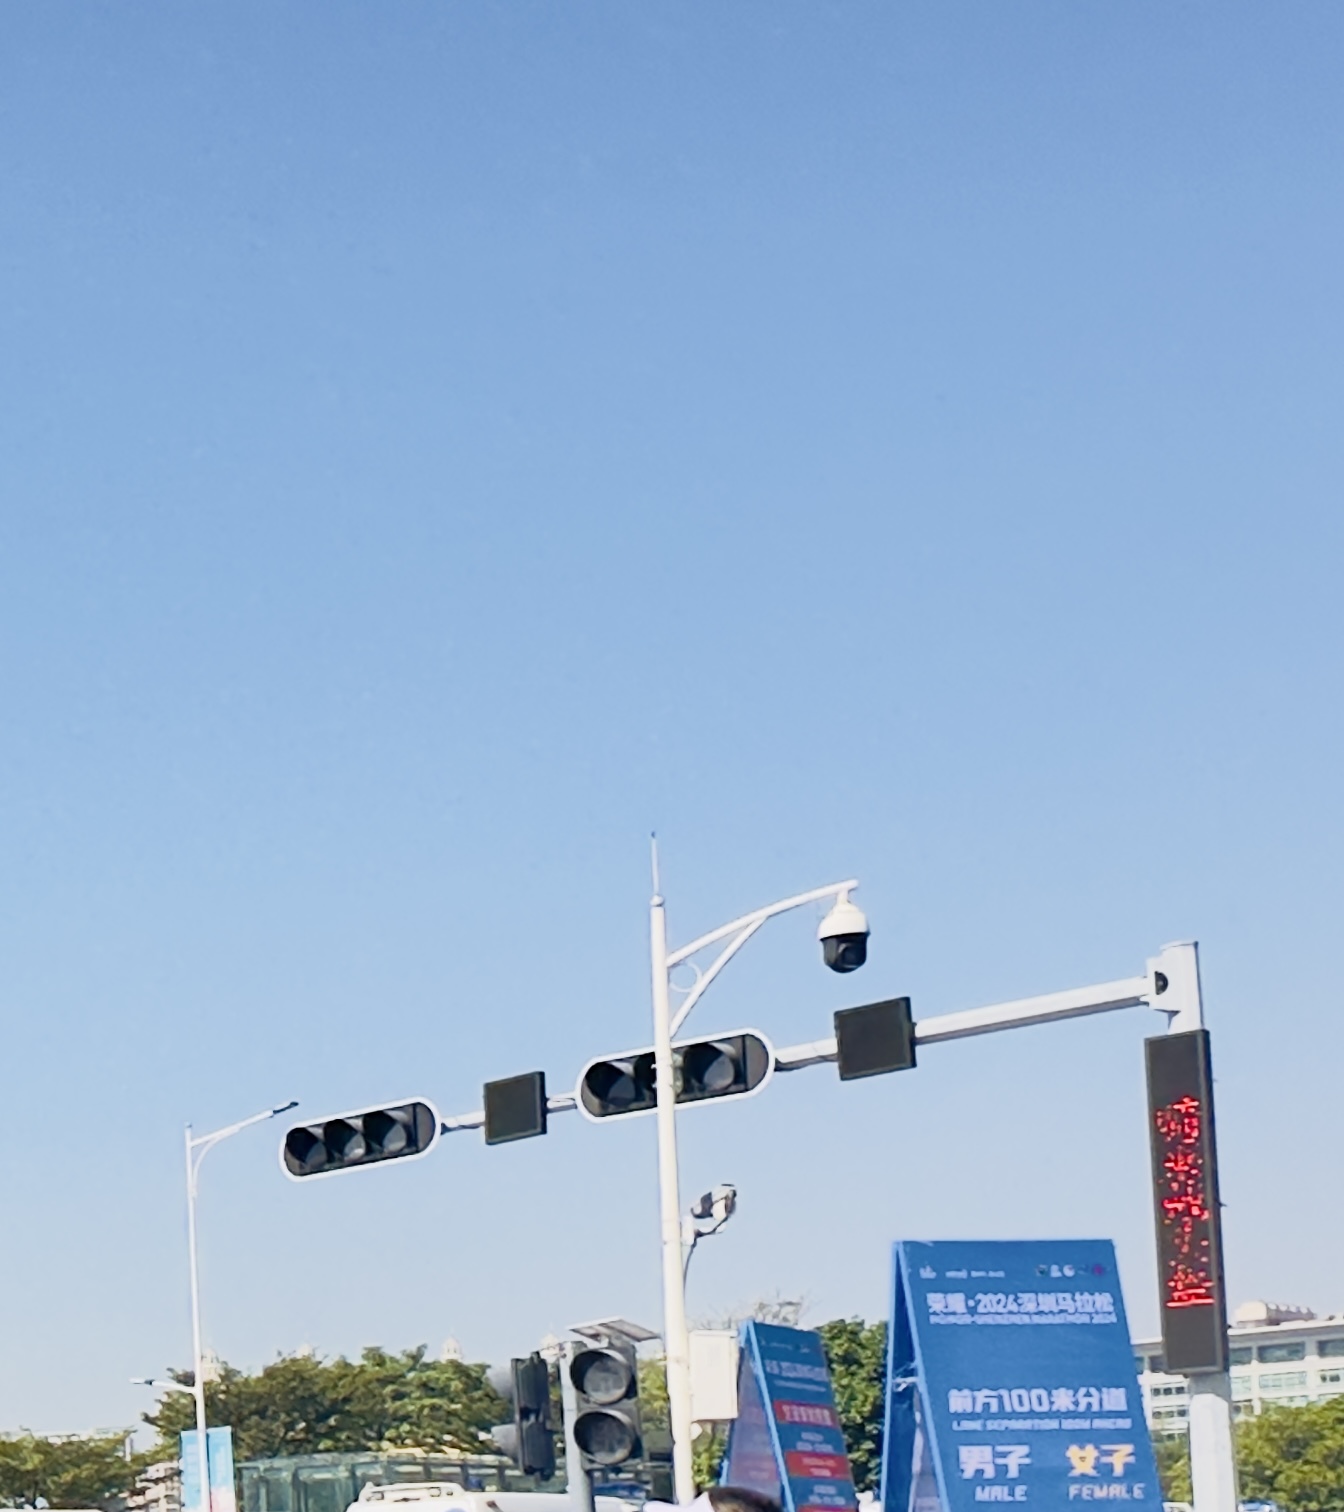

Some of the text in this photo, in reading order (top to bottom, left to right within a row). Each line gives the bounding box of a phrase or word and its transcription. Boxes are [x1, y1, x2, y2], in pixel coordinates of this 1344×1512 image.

[948, 1387, 1128, 1413] 前方100米分道
[959, 1444, 1136, 1479] 男子 女子
[975, 1483, 1146, 1501] MALE FEMALE
